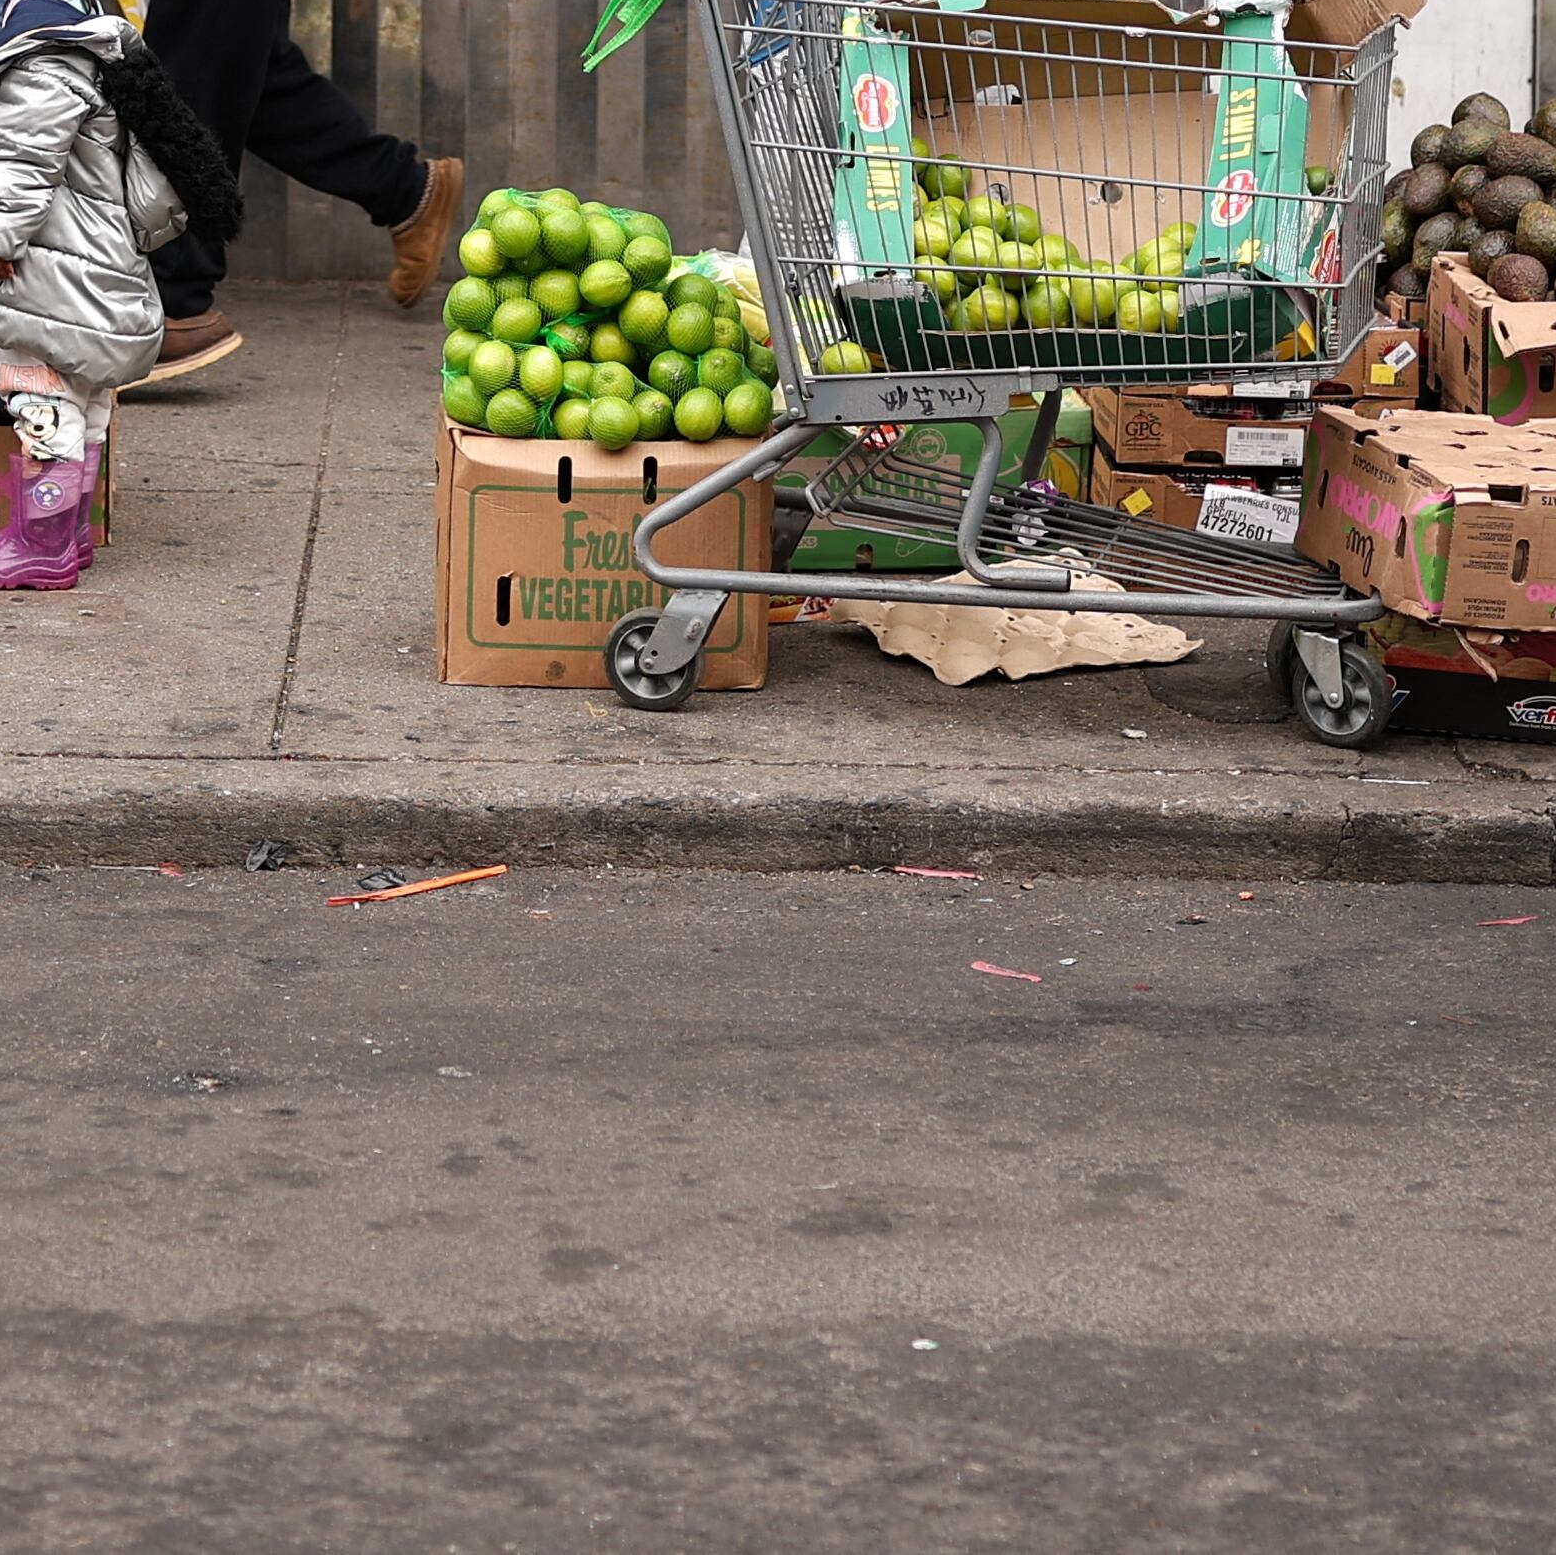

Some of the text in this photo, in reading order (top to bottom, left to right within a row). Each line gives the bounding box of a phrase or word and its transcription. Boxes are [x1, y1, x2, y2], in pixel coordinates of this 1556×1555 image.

[1219, 87, 1257, 162] LIMES
[866, 145, 901, 212] LIMES
[1210, 489, 1270, 510] STRAWBERRIES
[1200, 515, 1274, 543] 47272601
